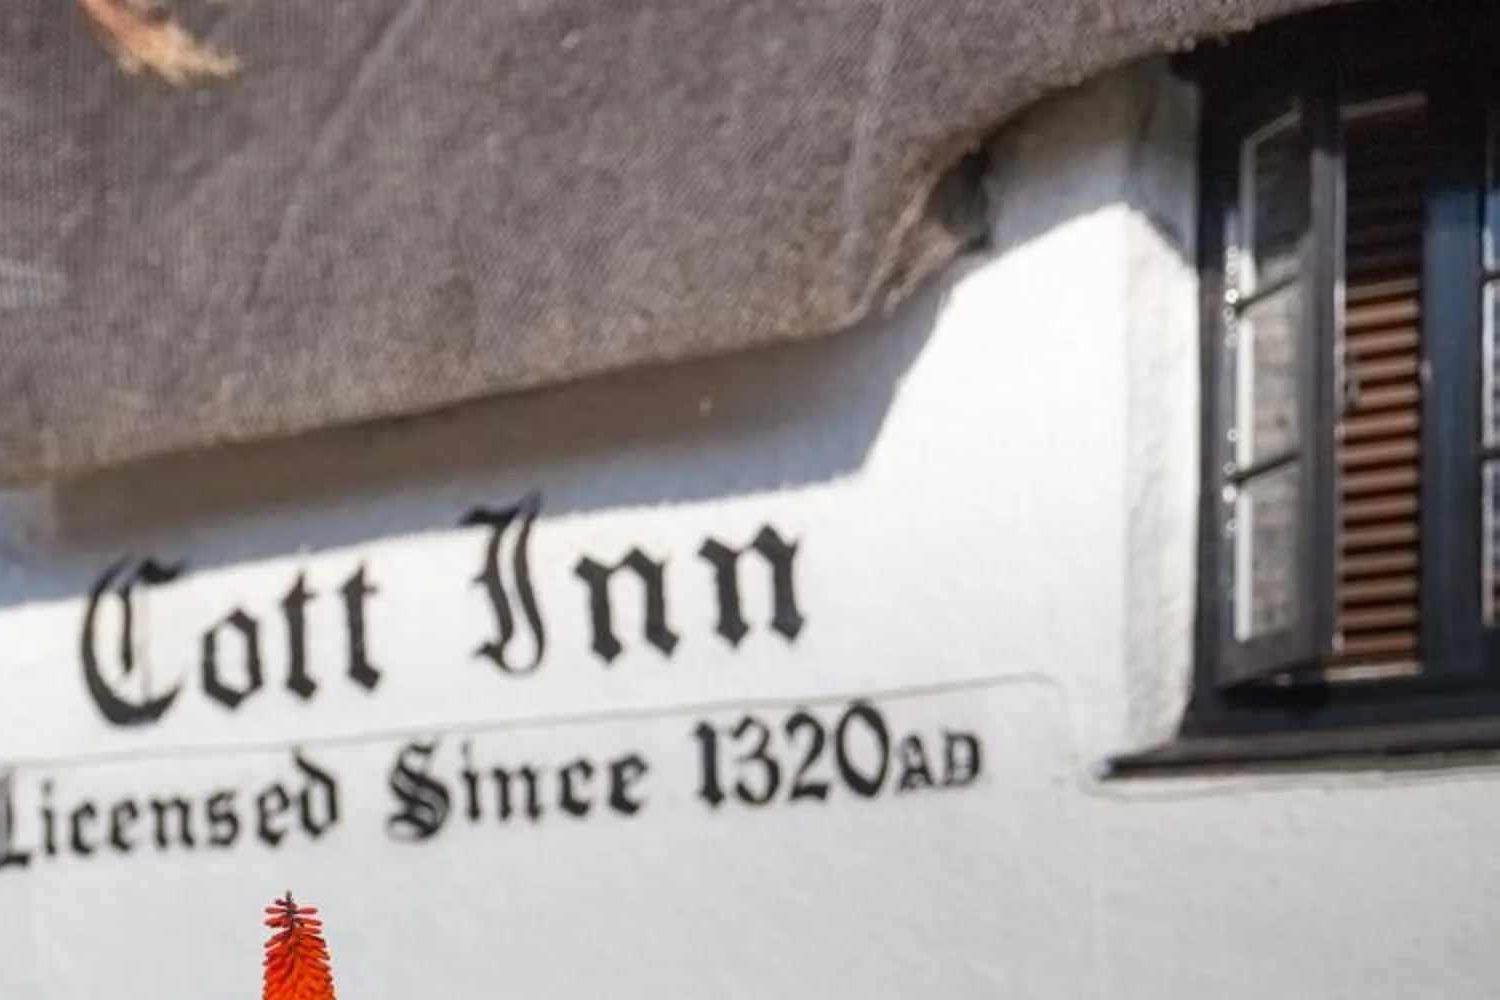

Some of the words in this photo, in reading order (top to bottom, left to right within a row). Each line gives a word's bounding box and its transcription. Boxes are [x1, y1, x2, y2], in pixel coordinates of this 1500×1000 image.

[79, 553, 382, 727] Cott
[462, 490, 806, 676] Inn
[385, 738, 649, 842] Since
